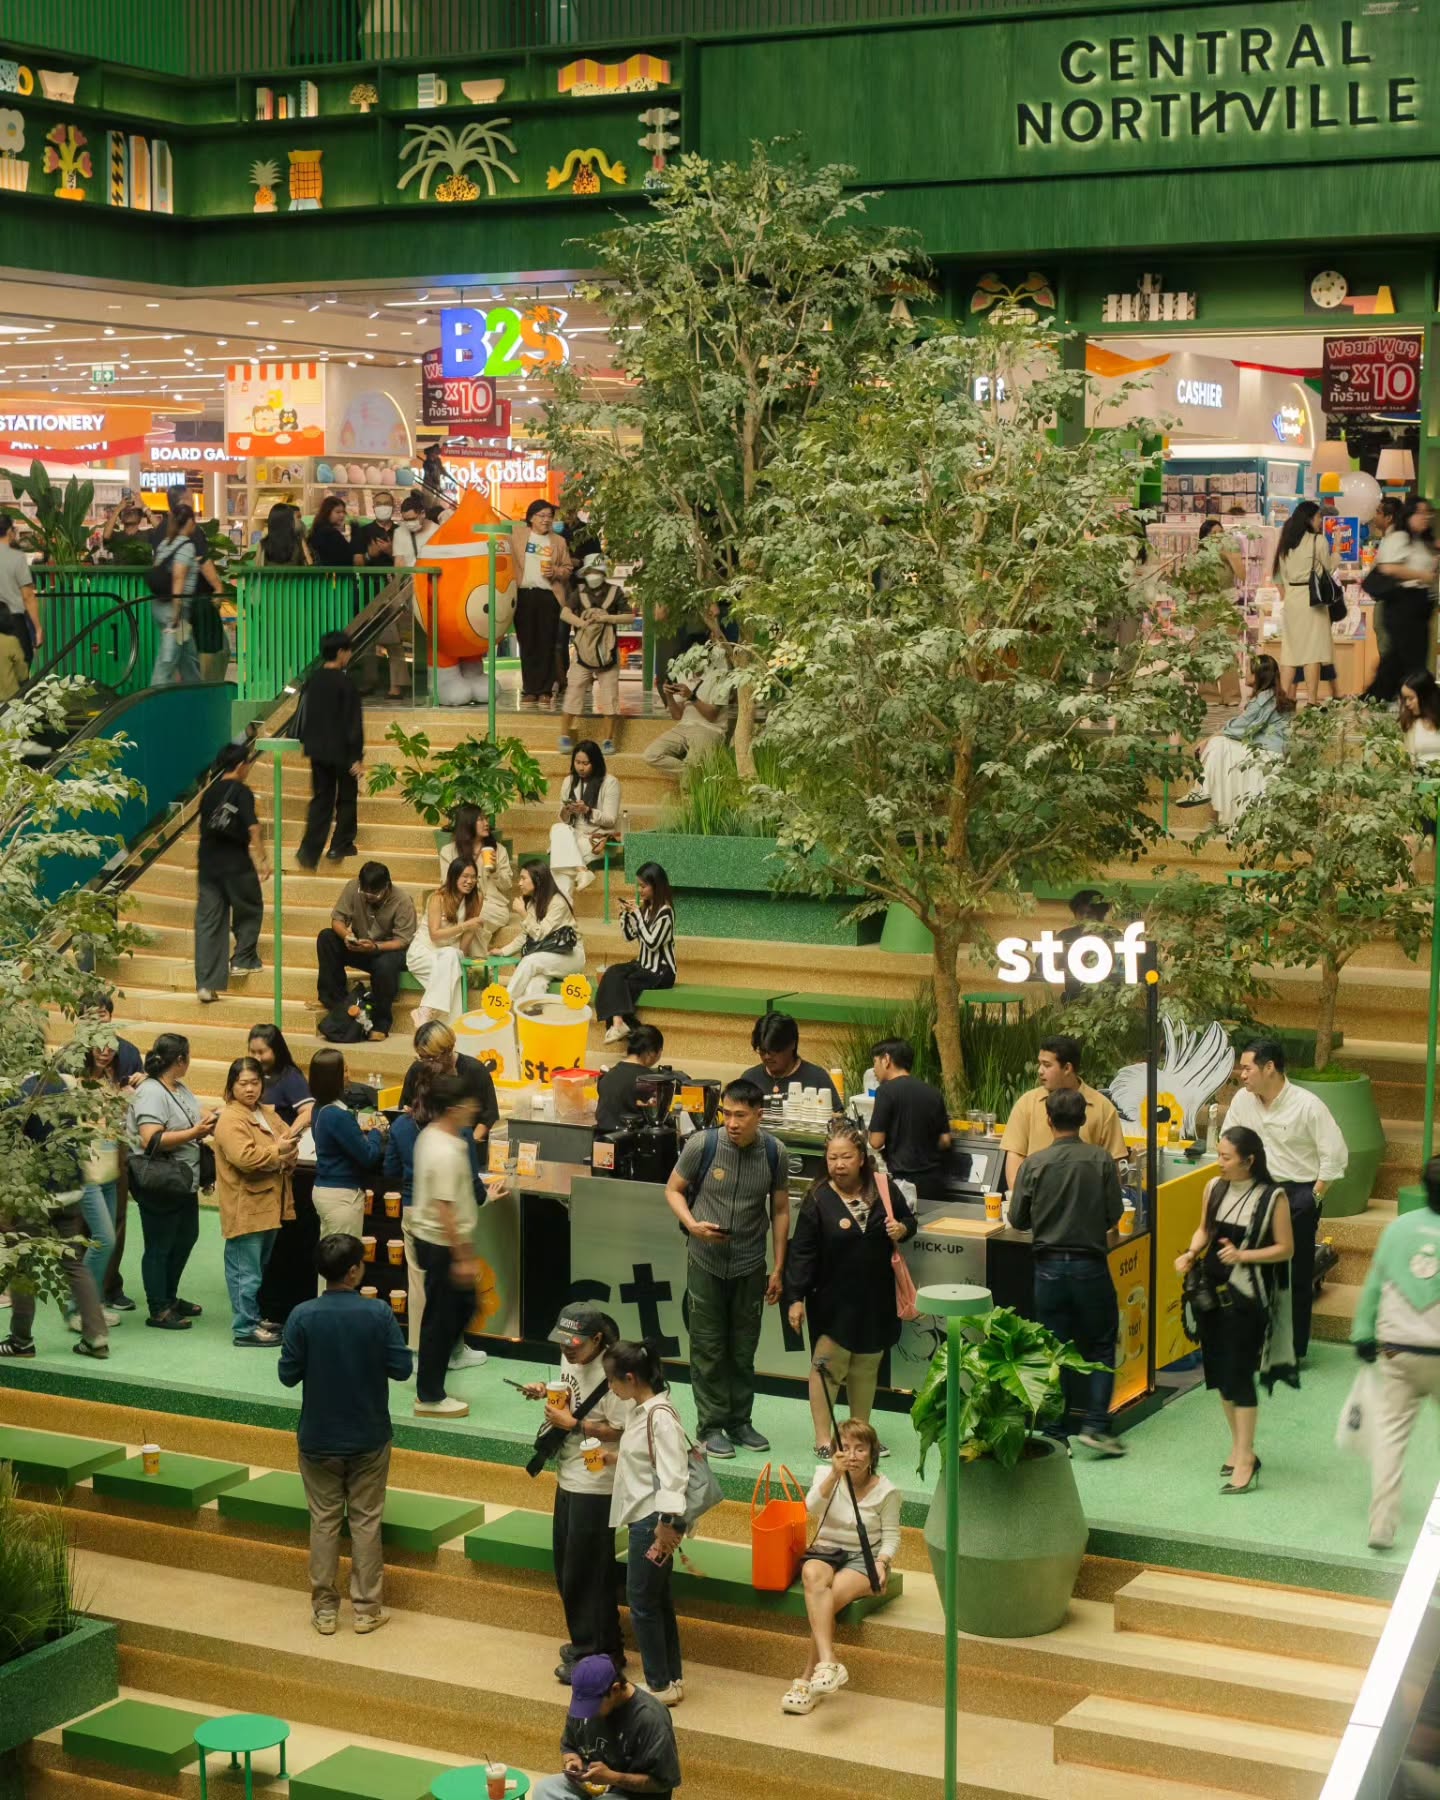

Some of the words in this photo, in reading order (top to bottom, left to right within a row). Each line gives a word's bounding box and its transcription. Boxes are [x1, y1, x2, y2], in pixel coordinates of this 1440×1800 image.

[1060, 20, 1372, 85] CENTRAL
[1016, 77, 1418, 146] NORTHVILLE
[441, 304, 569, 377] B2S
[1177, 378, 1223, 409] CASHIER
[1329, 384, 1370, 402] ทั้งร้าน
[429, 401, 460, 417] ทั้งร้าน
[0, 414, 105, 432] STATIONERY
[151, 447, 201, 461] BOARD
[203, 447, 247, 461] GA
[525, 542, 553, 558] B2S
[913, 1241, 964, 1255] PICK-UP
[1119, 1250, 1138, 1276] stof
